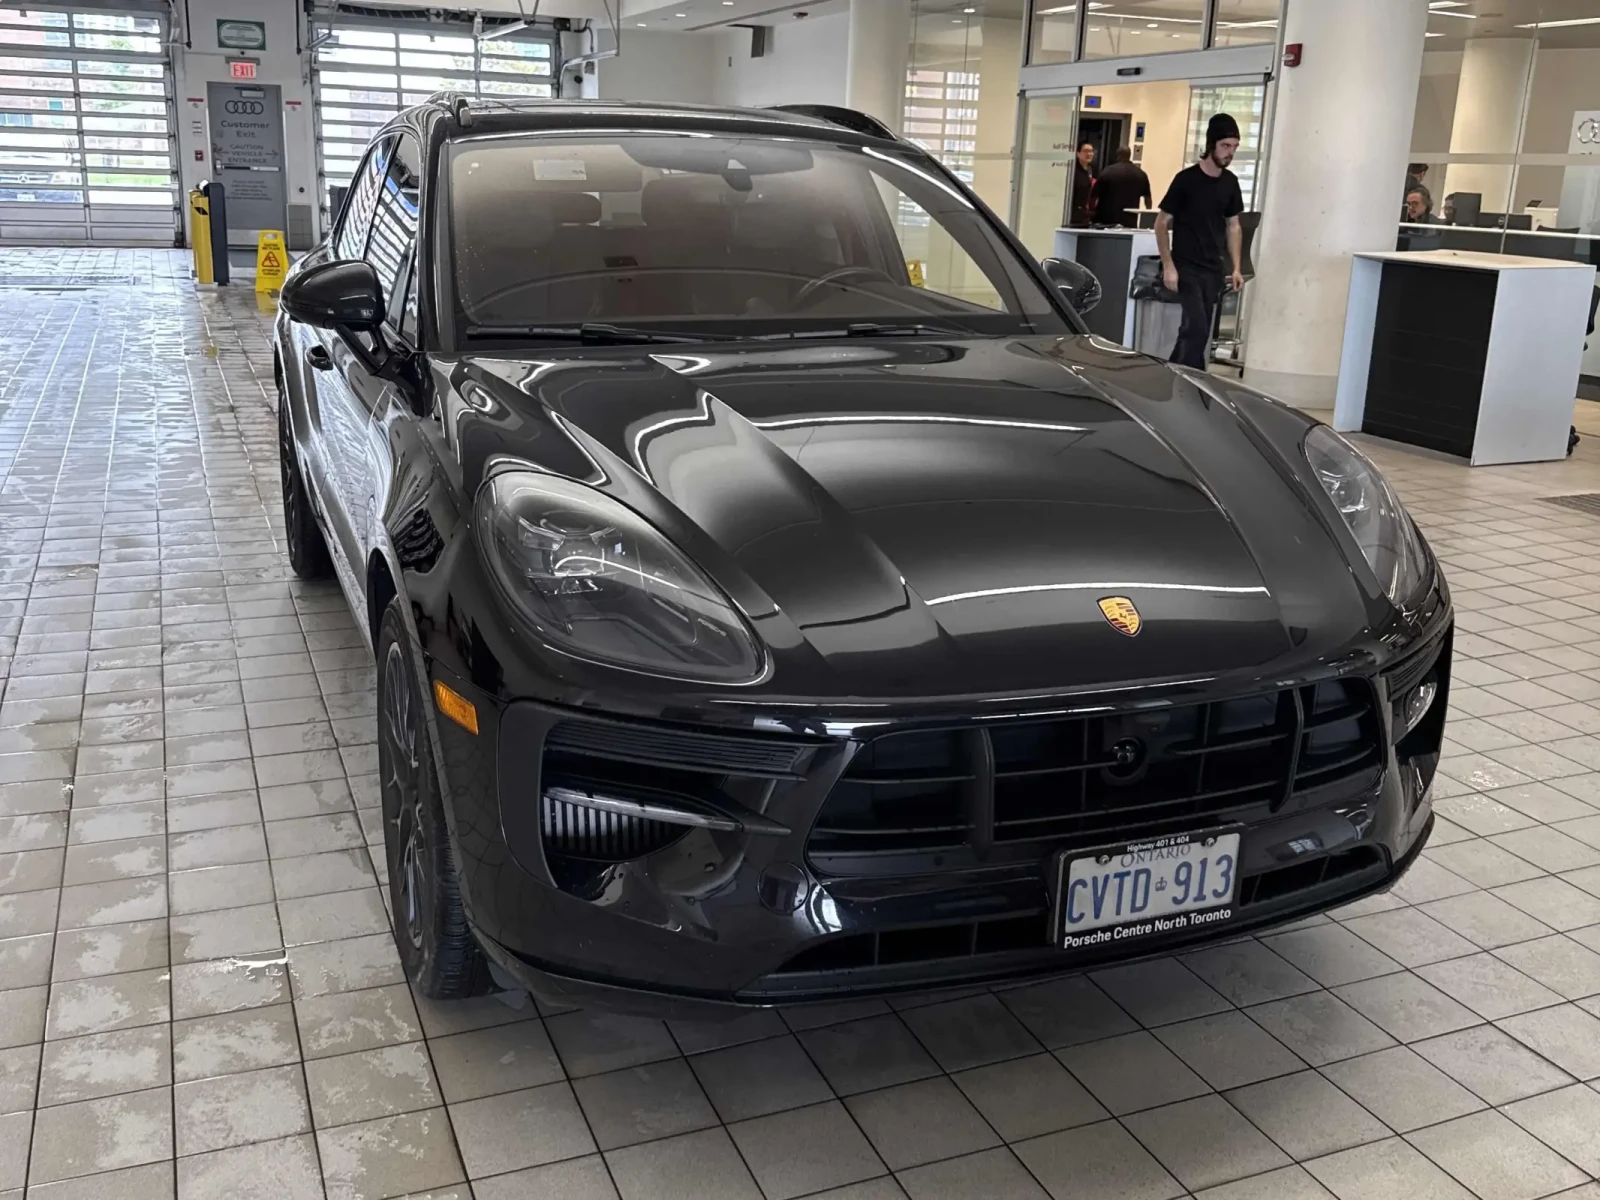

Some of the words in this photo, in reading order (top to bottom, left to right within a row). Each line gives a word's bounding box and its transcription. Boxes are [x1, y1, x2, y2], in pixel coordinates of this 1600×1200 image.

[233, 64, 254, 77] EXIT
[221, 120, 270, 129] Customer
[236, 130, 256, 138] Exit
[1127, 842, 1155, 853] Highway
[1156, 839, 1169, 847] 401
[1176, 836, 1190, 844] 404
[1121, 844, 1192, 868] ONTARIO
[1068, 868, 1151, 923] CVTD
[1171, 854, 1234, 905] 913
[1064, 930, 1111, 949] Porsche
[1114, 923, 1152, 939] Centre
[1154, 915, 1187, 932] North
[1189, 908, 1231, 925] Toronto
